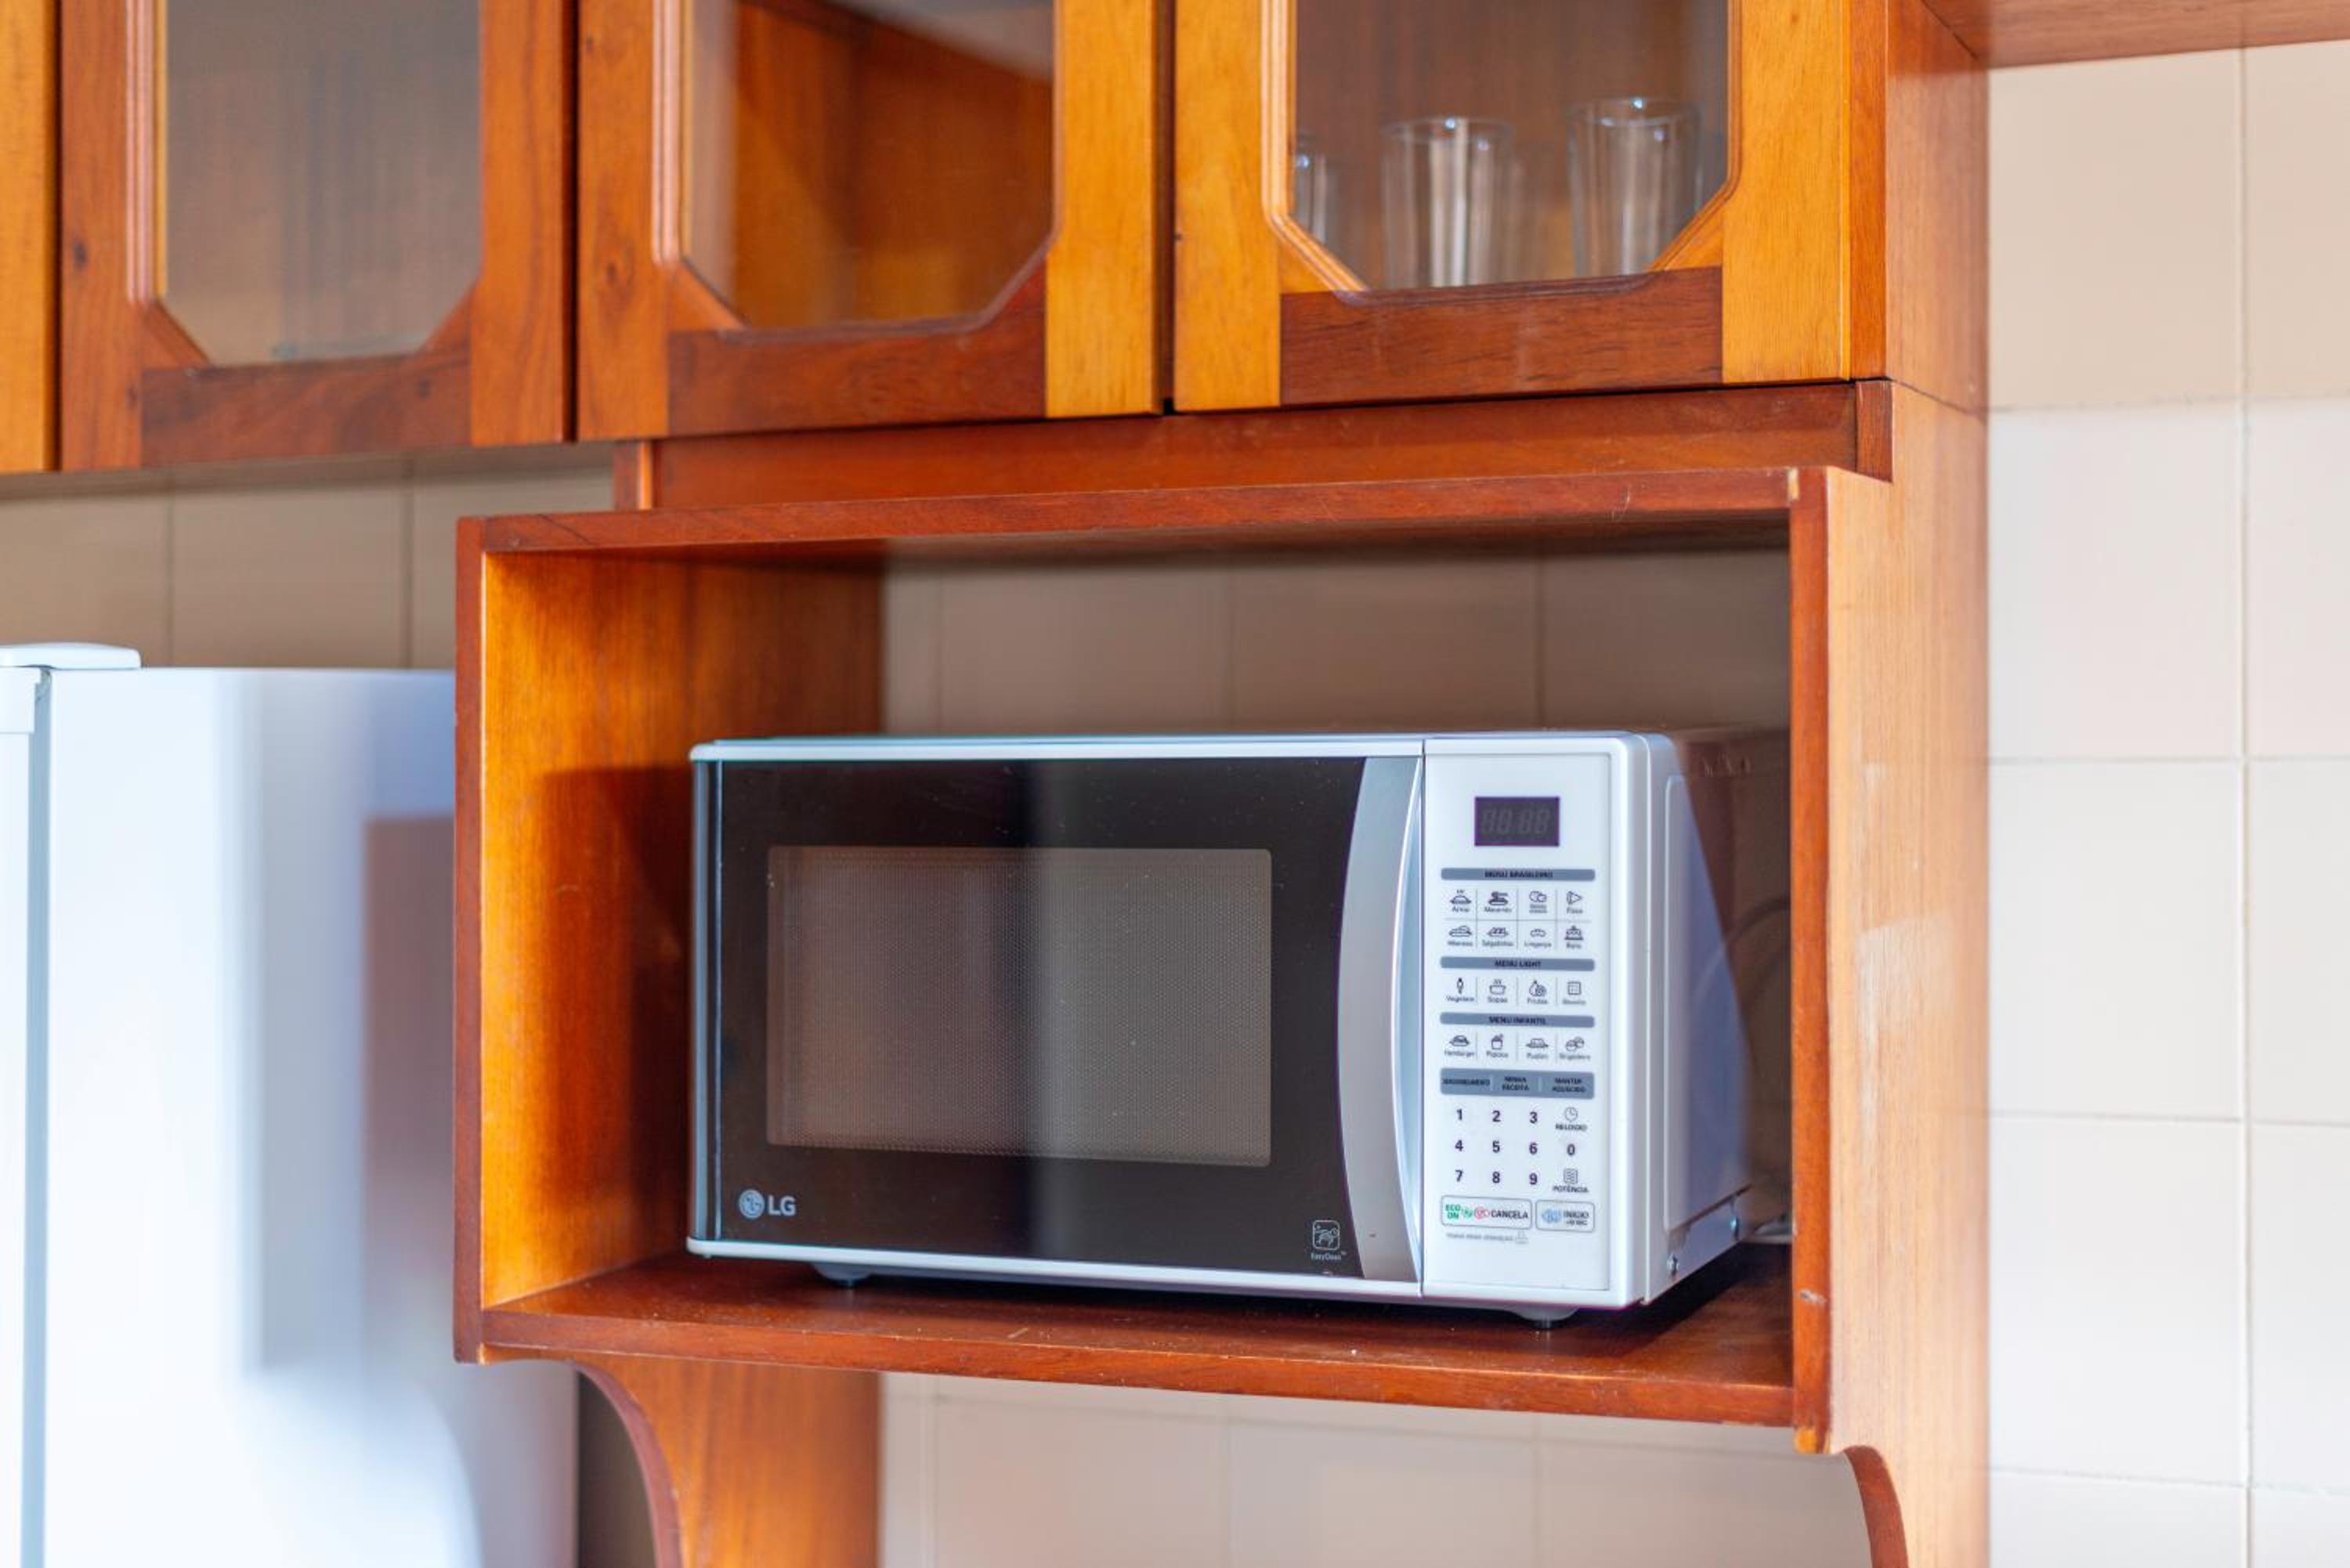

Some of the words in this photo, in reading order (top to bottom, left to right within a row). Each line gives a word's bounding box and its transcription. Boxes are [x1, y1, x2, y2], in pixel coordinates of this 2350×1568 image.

[1456, 1108, 1462, 1121] 1
[1492, 1110, 1501, 1122] 2
[1529, 1111, 1538, 1124] 3
[1455, 1140, 1463, 1152] 4
[1492, 1140, 1500, 1153] 5
[1529, 1142, 1538, 1154] 6
[1567, 1143, 1575, 1156] 0
[1455, 1169, 1463, 1182] 7
[1492, 1171, 1501, 1183] 8
[1529, 1172, 1538, 1185] 9
[768, 1194, 796, 1216] LG
[1491, 1210, 1528, 1219] CANCELA
